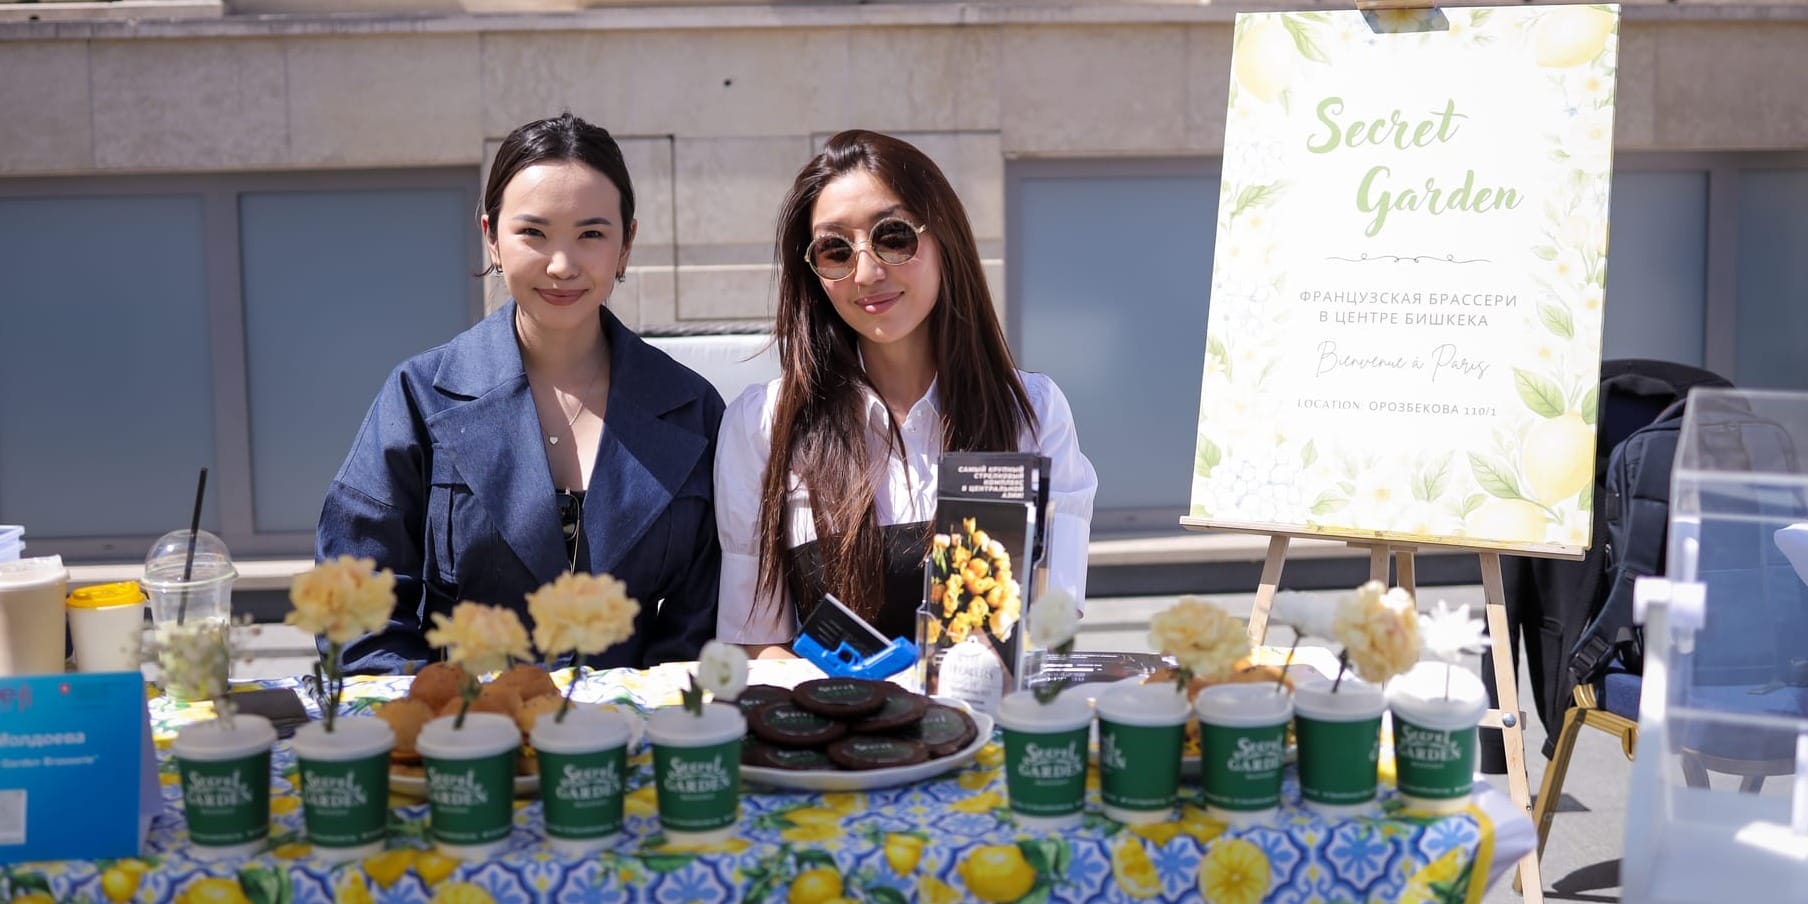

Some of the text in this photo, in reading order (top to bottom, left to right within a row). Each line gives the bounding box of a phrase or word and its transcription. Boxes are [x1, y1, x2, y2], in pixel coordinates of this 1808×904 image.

[1306, 96, 1469, 154] Secret
[1356, 165, 1524, 237] Garden
[1299, 290, 1518, 307] ФРАНЦУЗСКАЯ БРАССЕРИ
[1319, 311, 1488, 326] В ЦЕНТРЕ БИШКЕКА
[1316, 340, 1406, 377] Bienvenue
[1431, 343, 1490, 383] Paris
[1369, 401, 1459, 415] ОРОЗБЕКОВА
[1464, 406, 1496, 417] 110/1
